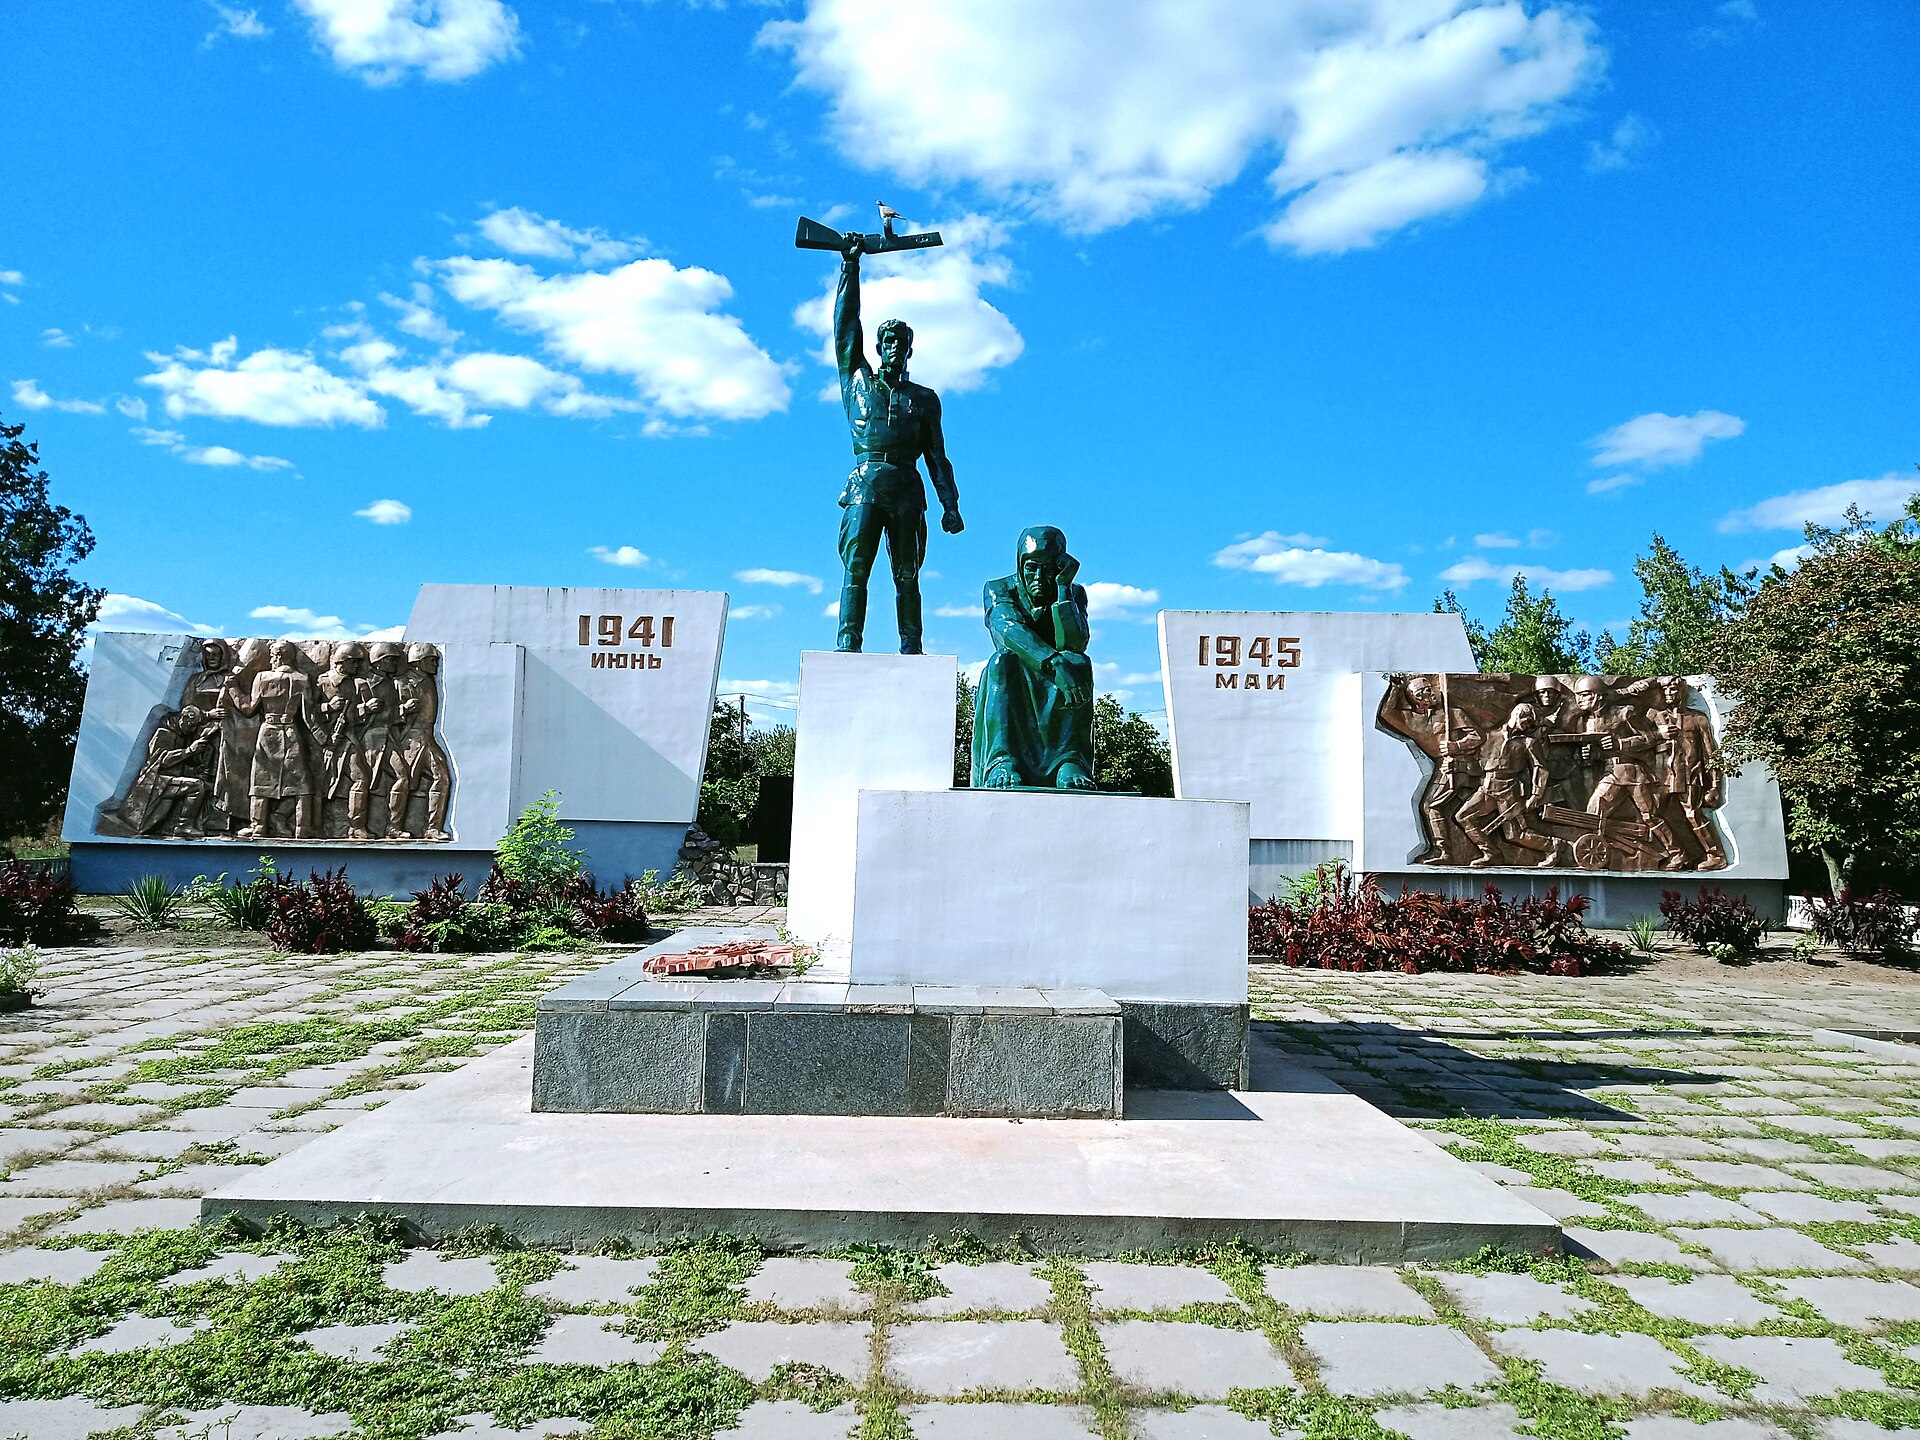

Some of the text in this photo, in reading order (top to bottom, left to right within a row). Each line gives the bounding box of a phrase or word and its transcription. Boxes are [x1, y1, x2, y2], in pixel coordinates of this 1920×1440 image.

[578, 615, 675, 647] 1941
[591, 652, 662, 670] ИЮНЬ
[1198, 635, 1301, 668] 1945
